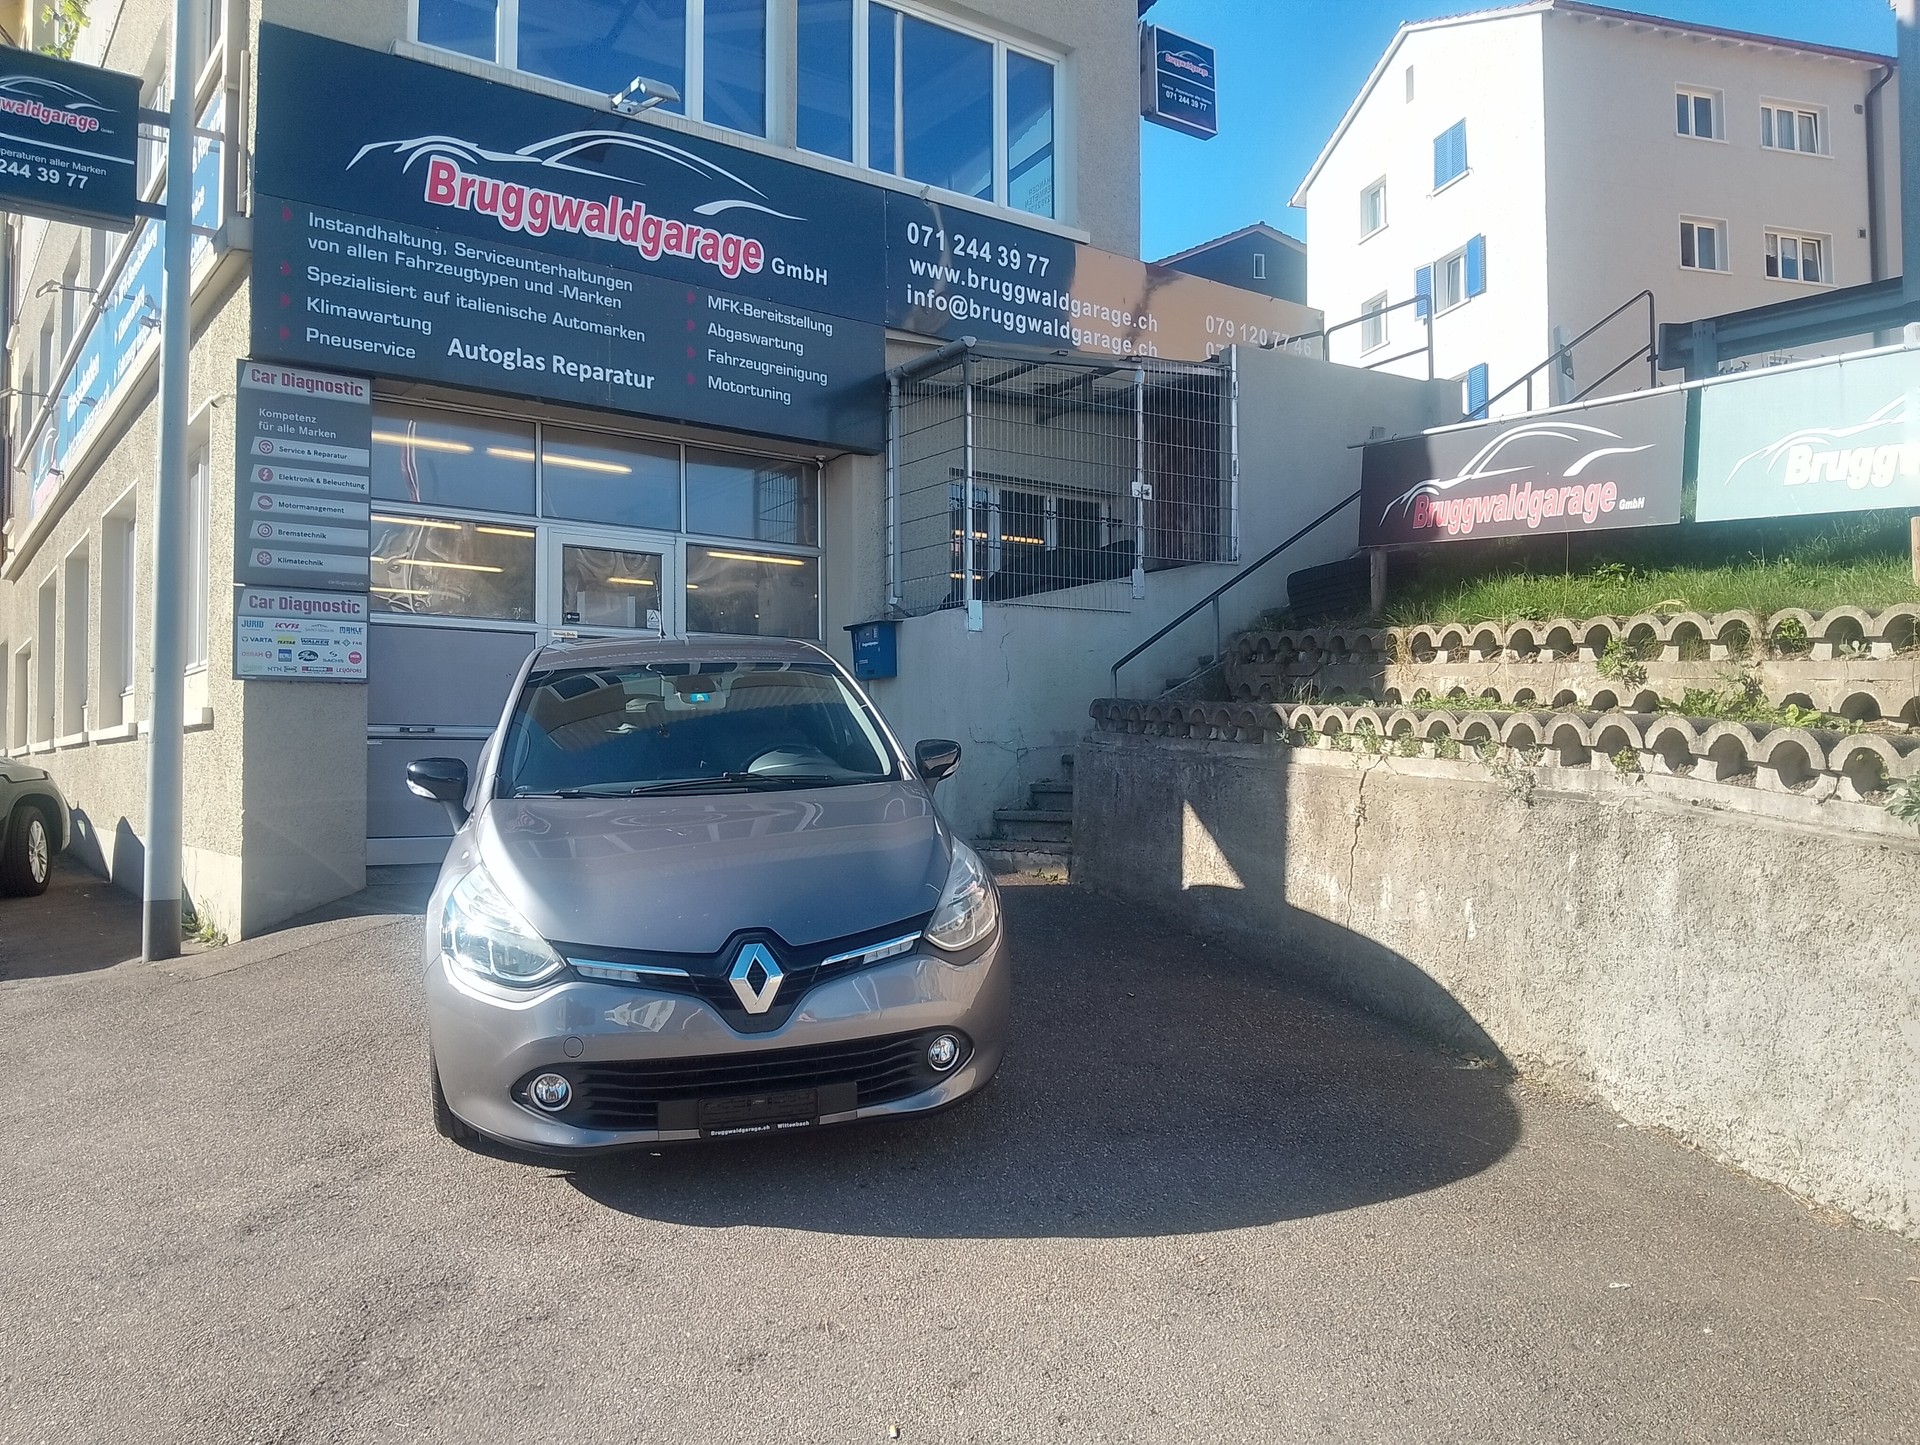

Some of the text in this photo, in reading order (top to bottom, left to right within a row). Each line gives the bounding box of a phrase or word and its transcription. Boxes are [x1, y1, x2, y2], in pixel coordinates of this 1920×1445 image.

[0, 96, 99, 133] waldgarage
[1166, 91, 1177, 101] 071
[1179, 95, 1190, 106] 244
[1191, 99, 1199, 108] 39
[1200, 103, 1207, 111] 77
[0, 159, 88, 189] 244 39 77
[50, 158, 70, 169] aller
[72, 161, 107, 176] Marken
[424, 155, 828, 285] Bruggwaldgarage GmbH
[308, 212, 633, 292] Instandhaltung, Serviceunterhaltungen
[907, 222, 1050, 277] 071 244 39 77
[308, 237, 622, 309] von allen Fahrzeugtypen und -Marken
[307, 266, 646, 343] Spezialisiert auf italienische Automarken
[909, 258, 1158, 332] www.bruggwaldgarage.ch
[306, 296, 432, 335] Klimawartung
[707, 295, 833, 337] MFK-Bereitstellung
[907, 284, 1158, 357] info@bruggwaldgarage.ch
[306, 327, 416, 359] Pneuservice
[707, 322, 804, 356] Abgaswartung
[1205, 315, 1312, 355] 079 120 77 46
[447, 338, 655, 390] Autoglas Reparatur
[707, 349, 828, 386] Fahrzeugreinigung
[251, 368, 363, 396] Car Diagnostic
[708, 375, 791, 405] Motortuning
[258, 408, 317, 424] Kompetenz
[258, 421, 337, 439] für alle Marken
[279, 446, 306, 455] Service
[314, 450, 348, 460] Reparatur
[278, 473, 314, 483] Elektronik
[323, 478, 366, 490] Beleuchtung
[278, 501, 345, 514] Motormanagement
[1413, 481, 1645, 535] Bruggwaldgarage GmbH
[278, 529, 327, 539] Bremstechnik
[277, 557, 324, 567] Klimatechnik
[249, 595, 361, 615] Car Diagnostic
[241, 620, 264, 629] JURID
[710, 1120, 810, 1136] Bruggwaldgarage.ch Wittenbach
